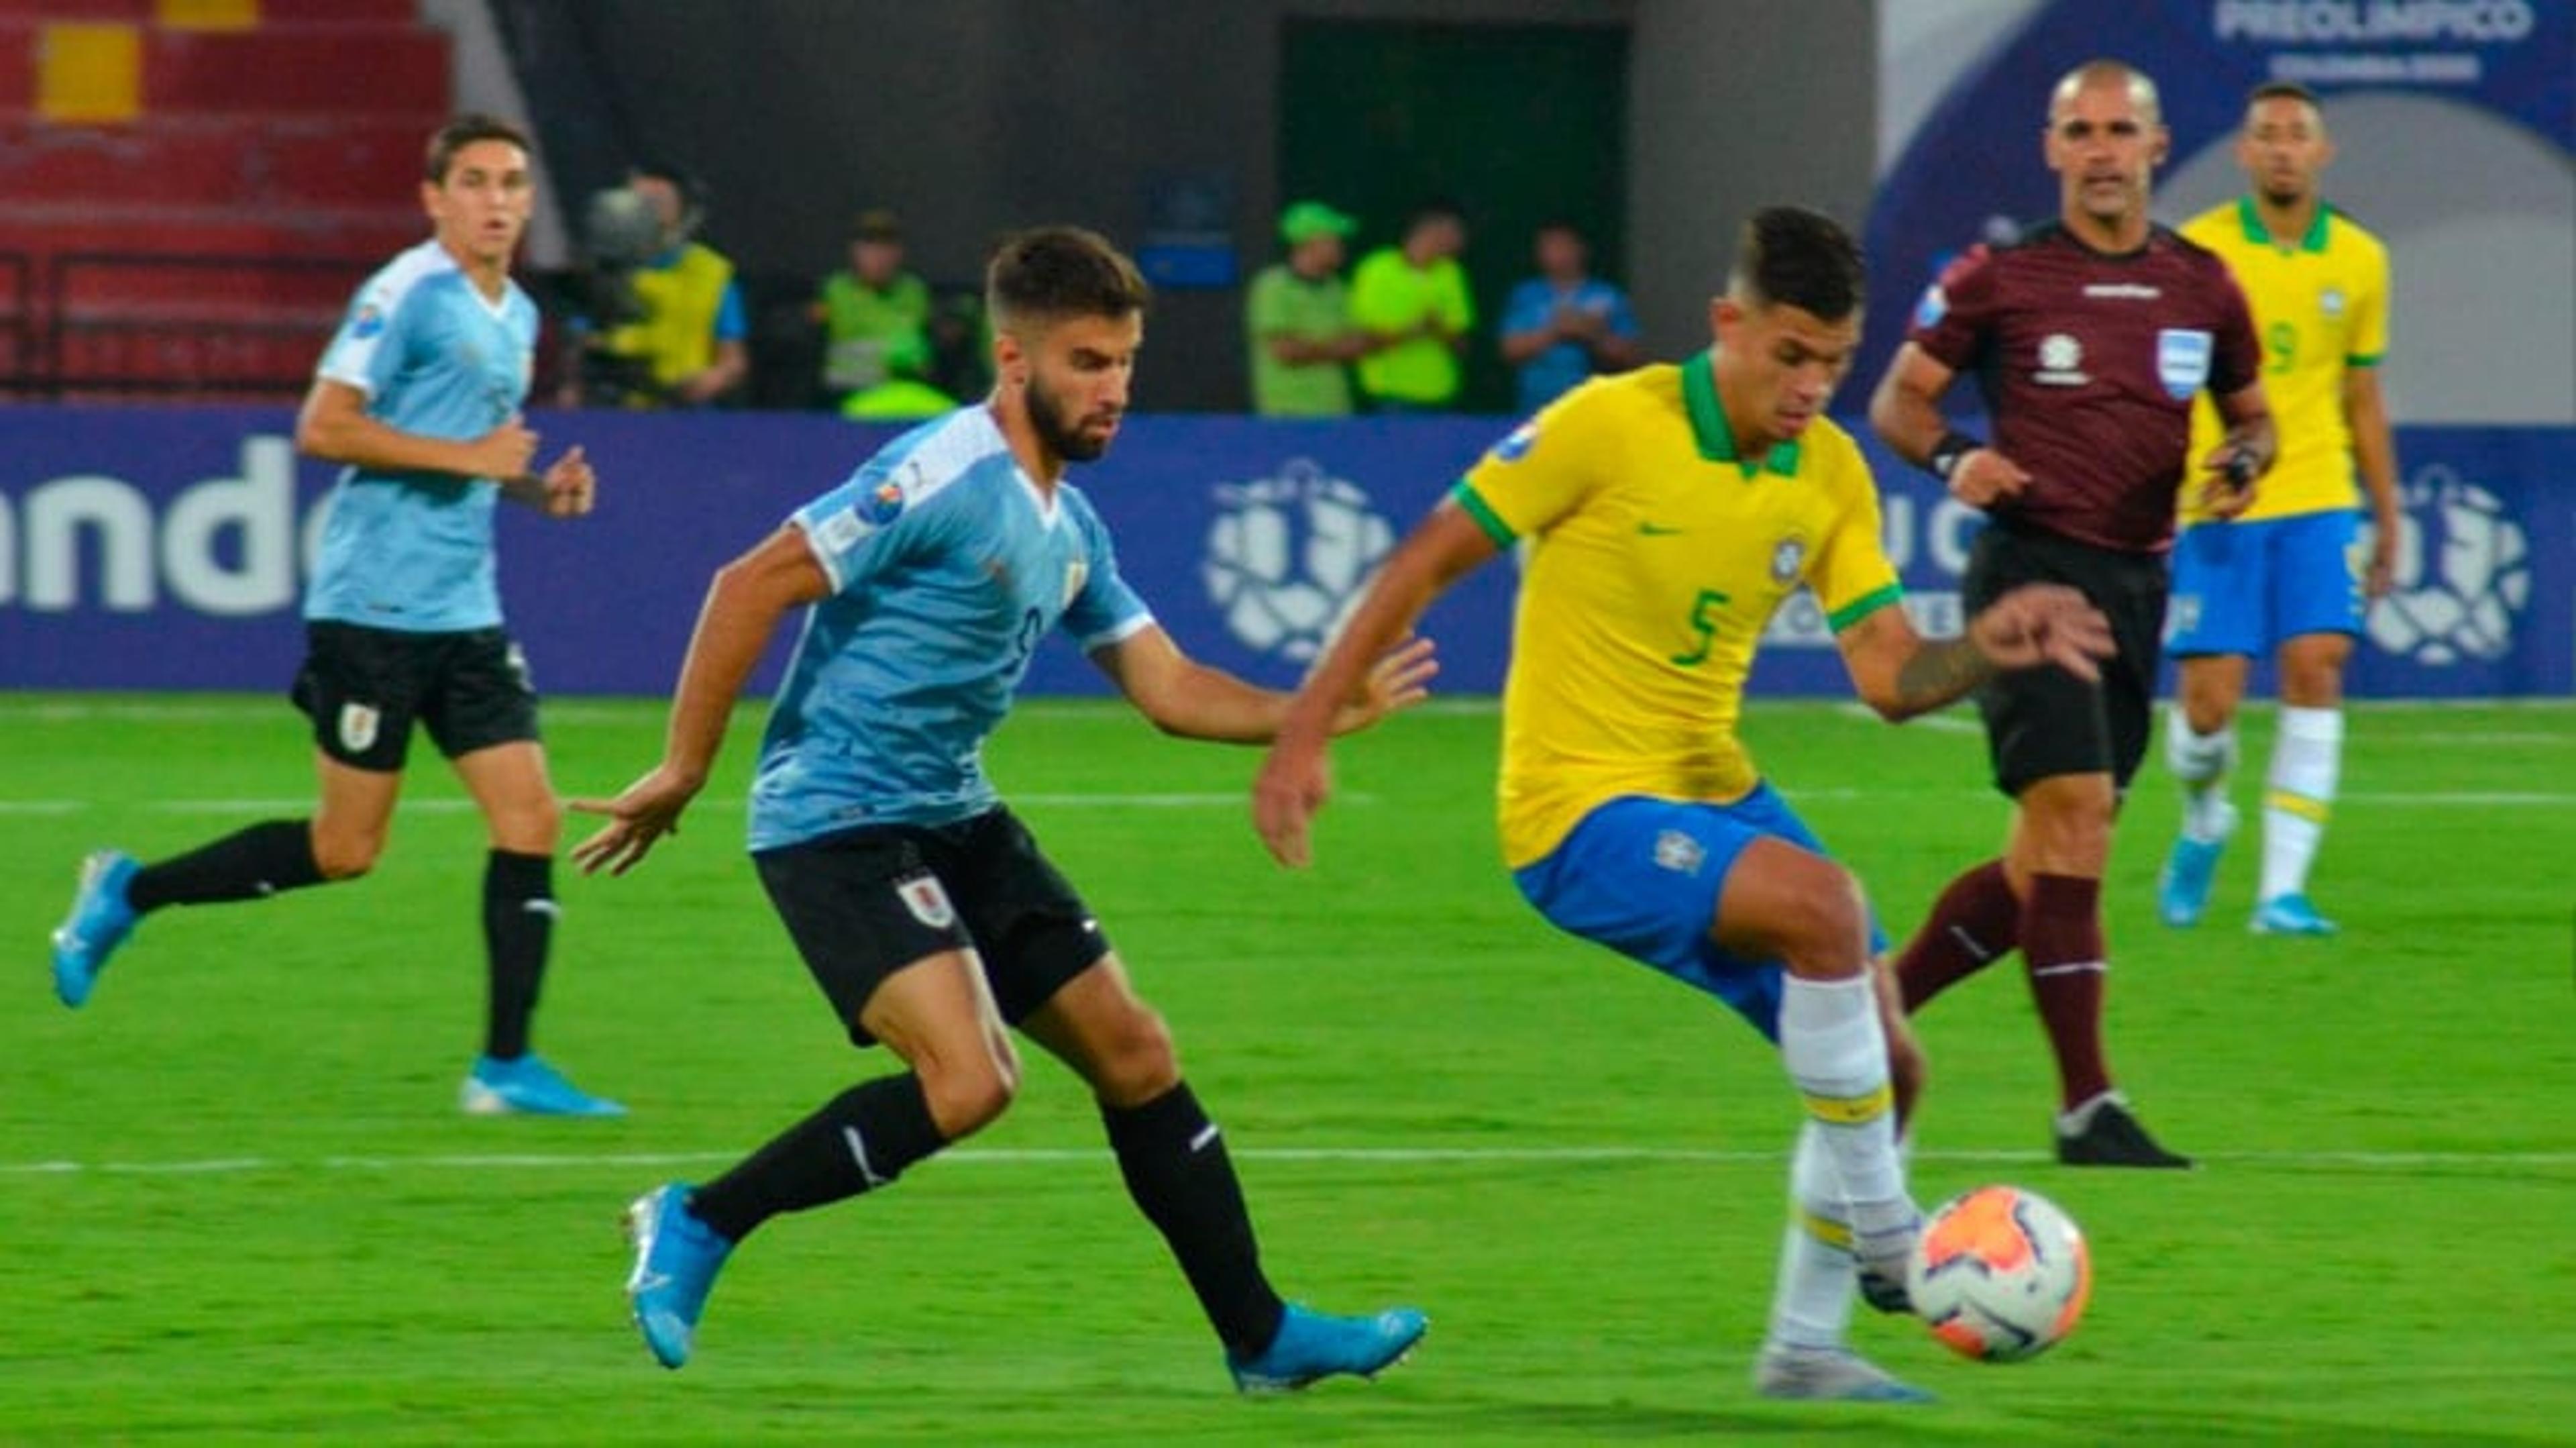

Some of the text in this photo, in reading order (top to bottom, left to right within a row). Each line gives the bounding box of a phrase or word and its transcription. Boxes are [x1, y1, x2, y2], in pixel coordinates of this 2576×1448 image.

[2266, 320, 2297, 375] 9
[0, 435, 323, 615] nd
[1670, 589, 1731, 666] 5
